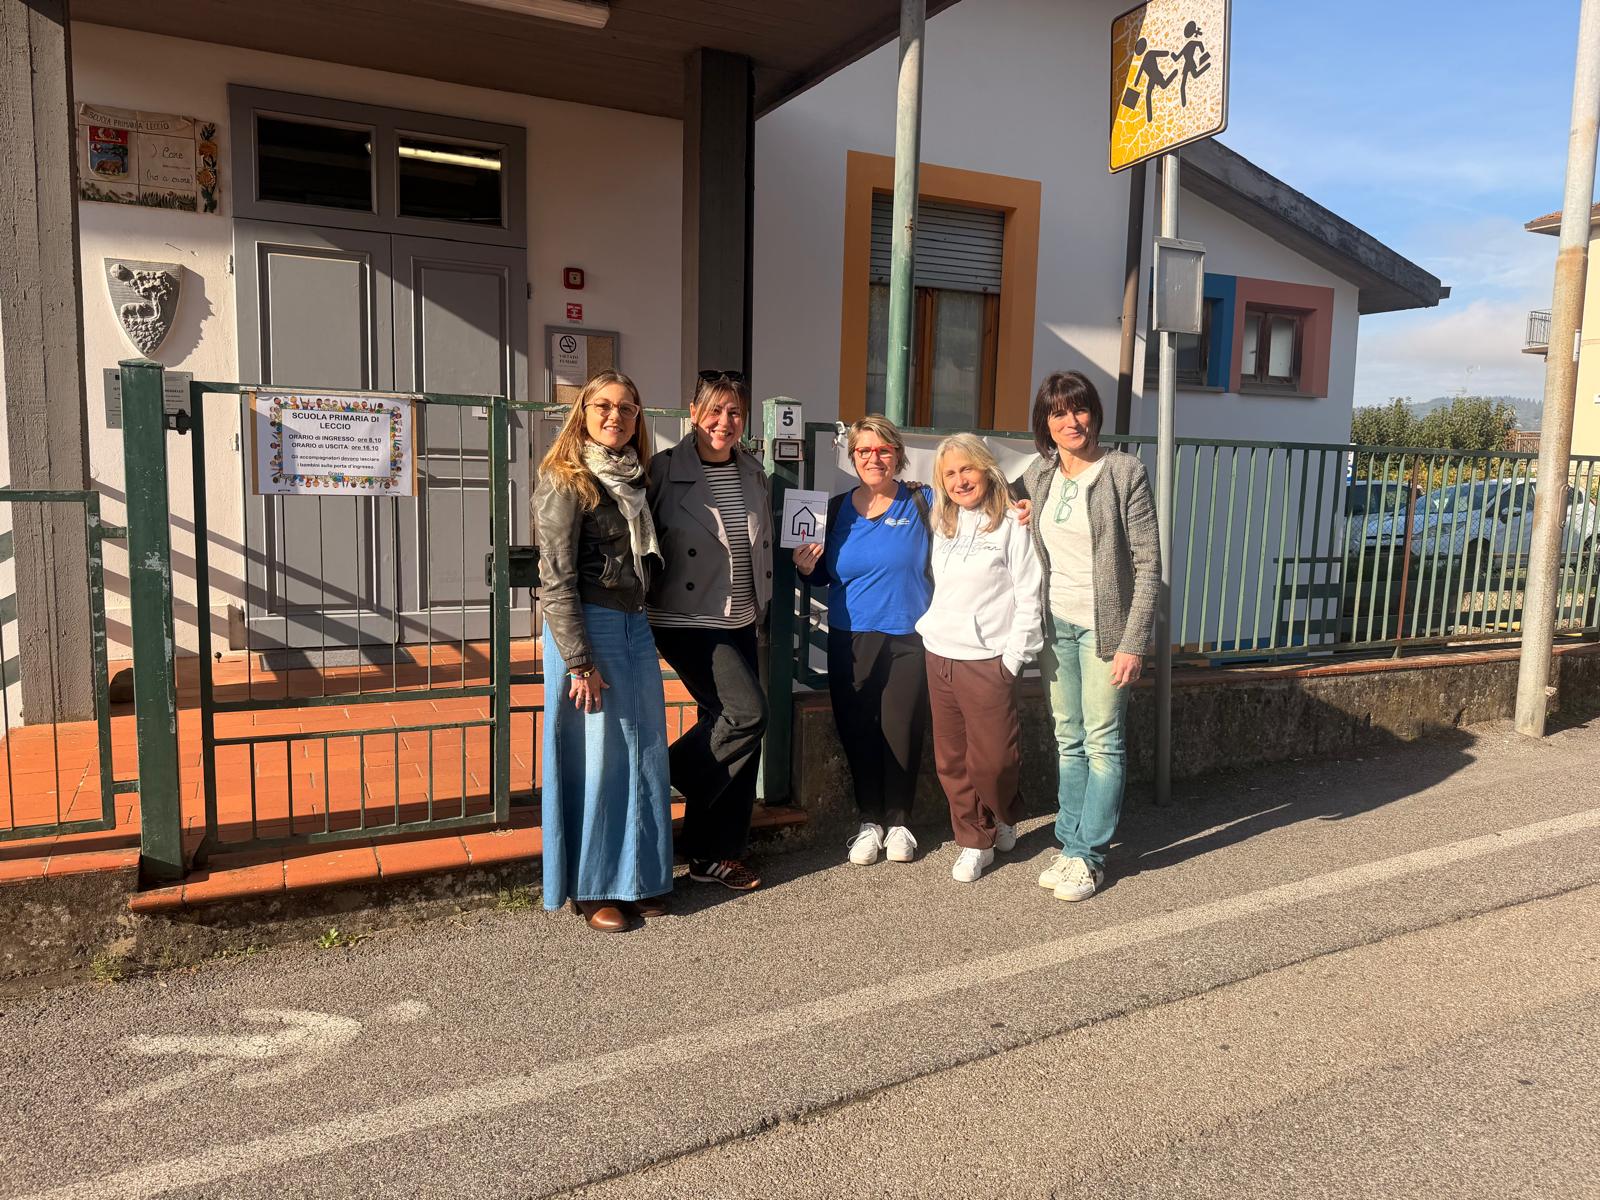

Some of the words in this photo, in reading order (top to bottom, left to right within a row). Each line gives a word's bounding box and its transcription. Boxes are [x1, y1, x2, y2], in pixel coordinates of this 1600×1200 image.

[292, 412, 328, 421] SCUOLA
[329, 413, 369, 423] PRIMARIA
[782, 410, 794, 427] 5
[320, 422, 351, 430] LECCIO
